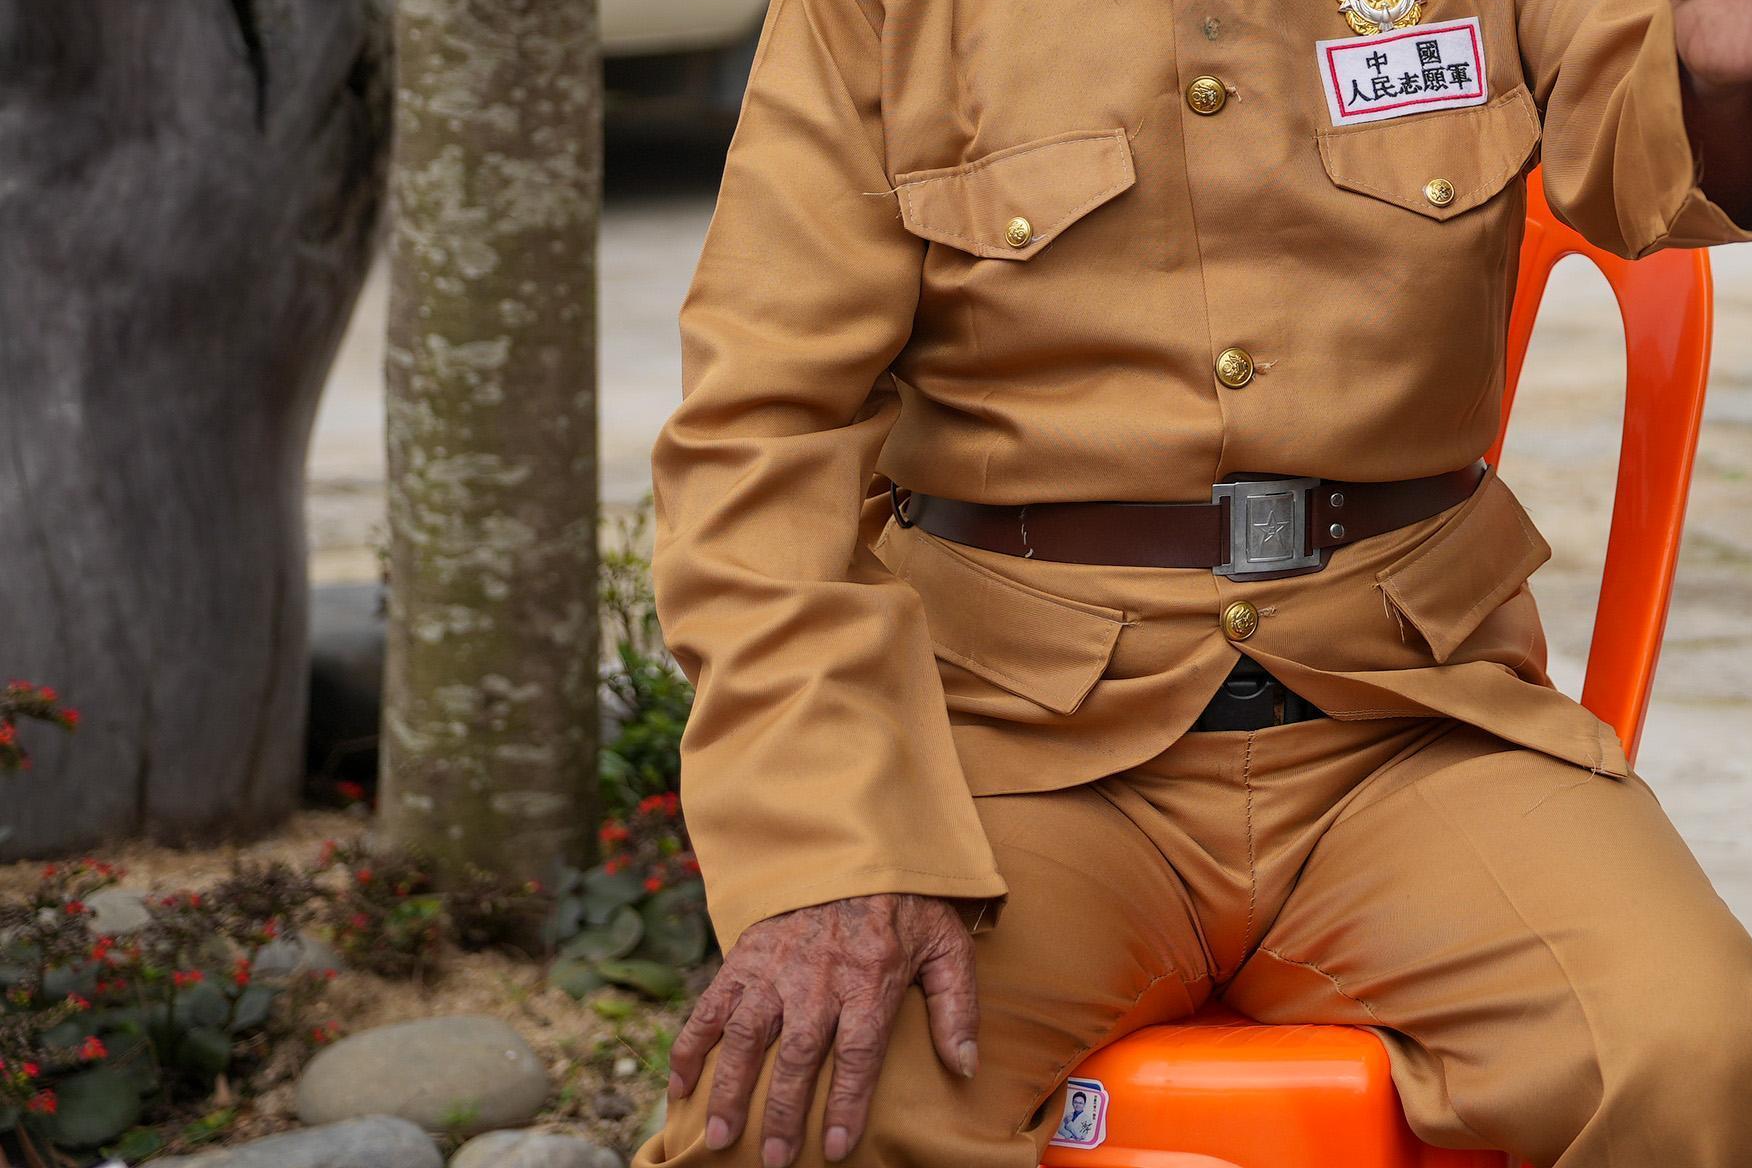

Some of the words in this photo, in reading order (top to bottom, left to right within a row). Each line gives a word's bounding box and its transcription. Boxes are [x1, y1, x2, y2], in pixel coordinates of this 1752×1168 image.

[1366, 39, 1443, 74] 中國
[1348, 62, 1472, 106] 人民志願軍
